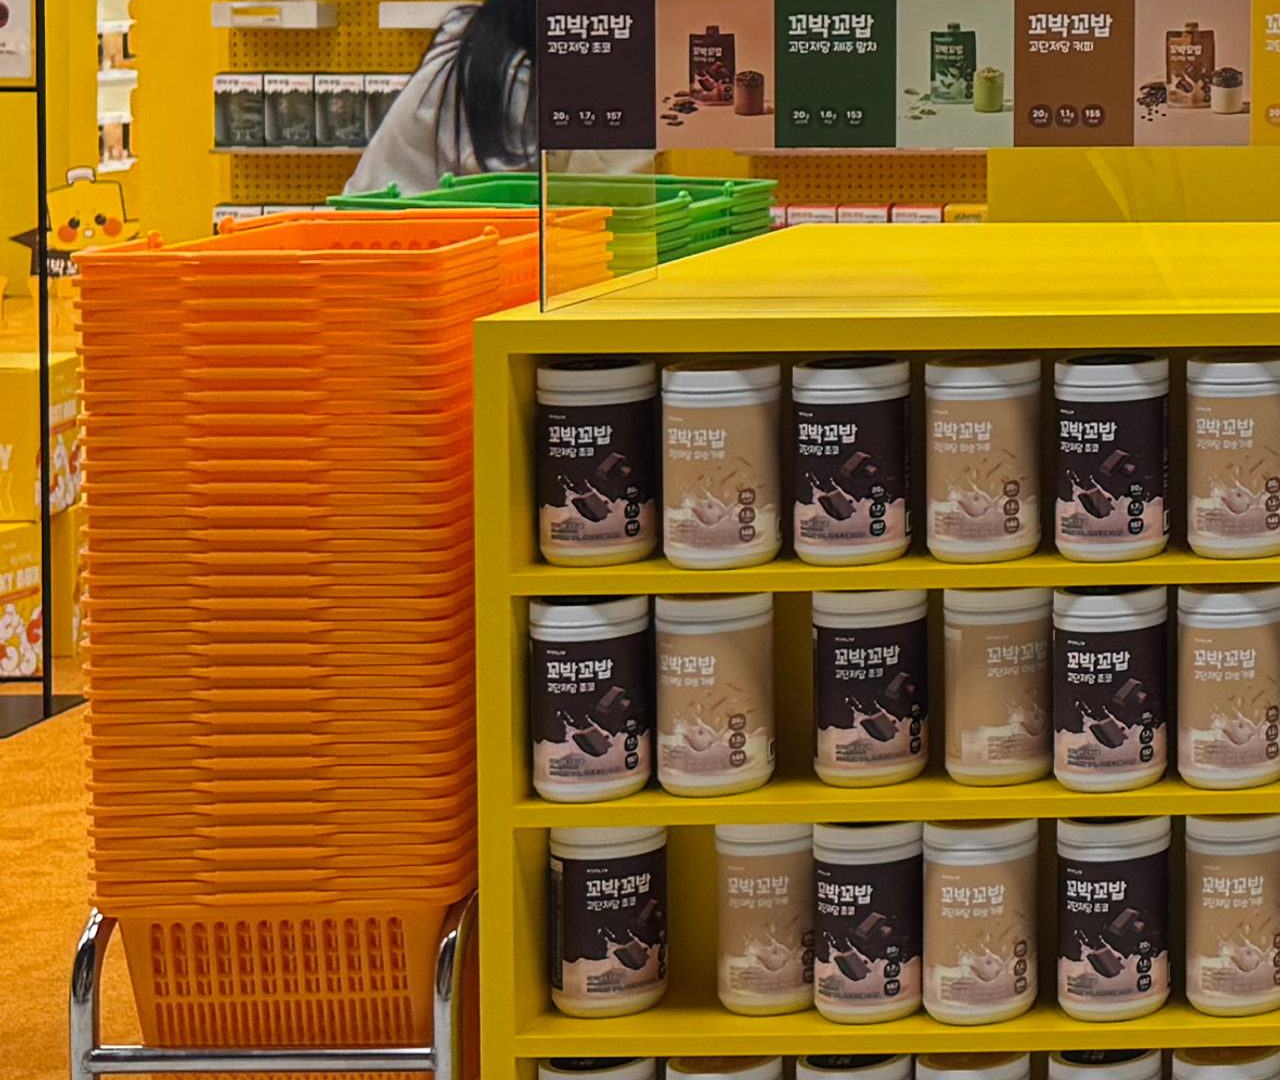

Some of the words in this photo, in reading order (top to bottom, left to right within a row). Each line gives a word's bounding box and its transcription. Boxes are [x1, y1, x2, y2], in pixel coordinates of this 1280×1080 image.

[547, 14, 633, 39] 꼬박꼬밥
[788, 14, 874, 39] 꼬박꼬밥
[1028, 13, 1113, 38] 꼬박꼬밥
[547, 41, 590, 54] 고단저당
[591, 41, 611, 54] 초코
[788, 41, 830, 54] 고단저당
[1029, 40, 1070, 53] 고단저당
[1073, 40, 1094, 52] 커피
[548, 424, 613, 447] 꼬박꼬밥
[798, 423, 858, 445] 꼬박꼬밥
[1060, 420, 1118, 441] 꼬박꼬밥
[834, 645, 901, 667] 꼬박꼬밥
[1067, 650, 1131, 672] 꼬박꼬밥
[546, 659, 613, 680] 꼬박꼬밥
[585, 873, 652, 898] 꼬박꼬밥
[817, 882, 874, 904] 꼬박꼬밥
[1066, 879, 1127, 902] 꼬박꼬밥
